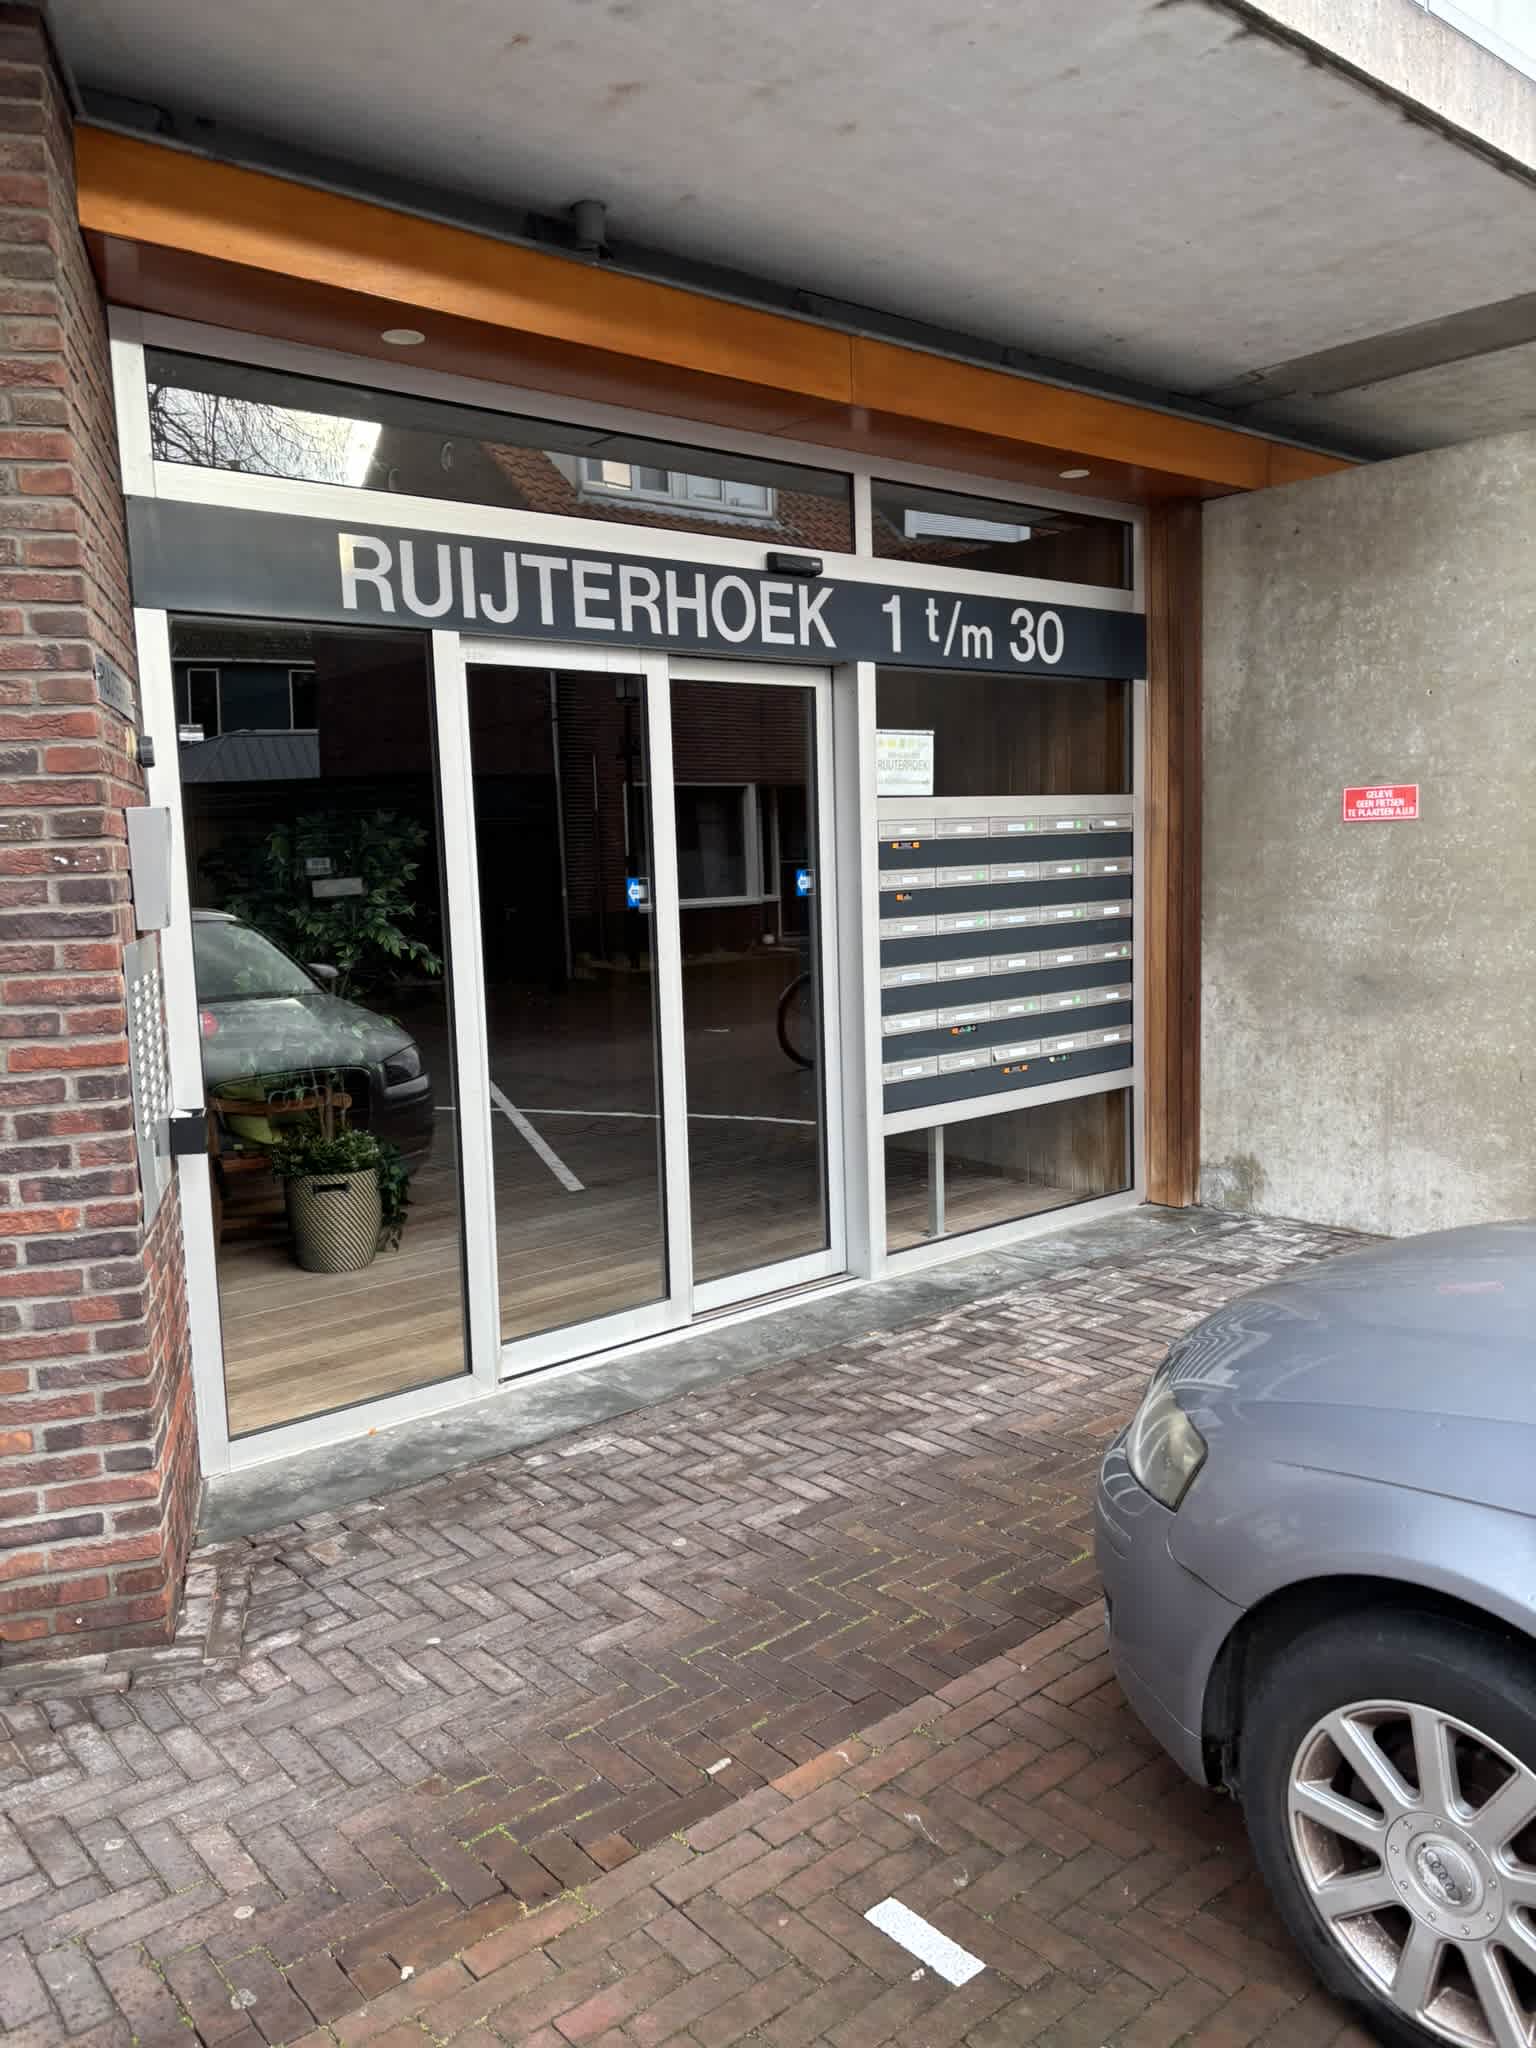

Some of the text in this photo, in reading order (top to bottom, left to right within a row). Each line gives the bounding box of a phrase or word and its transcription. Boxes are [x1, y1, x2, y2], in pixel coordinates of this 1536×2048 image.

[338, 532, 1064, 665] RUIJTERHOEK 1 t/m 30
[1356, 799, 1374, 808] GEEN
[1347, 808, 1356, 817] TE
